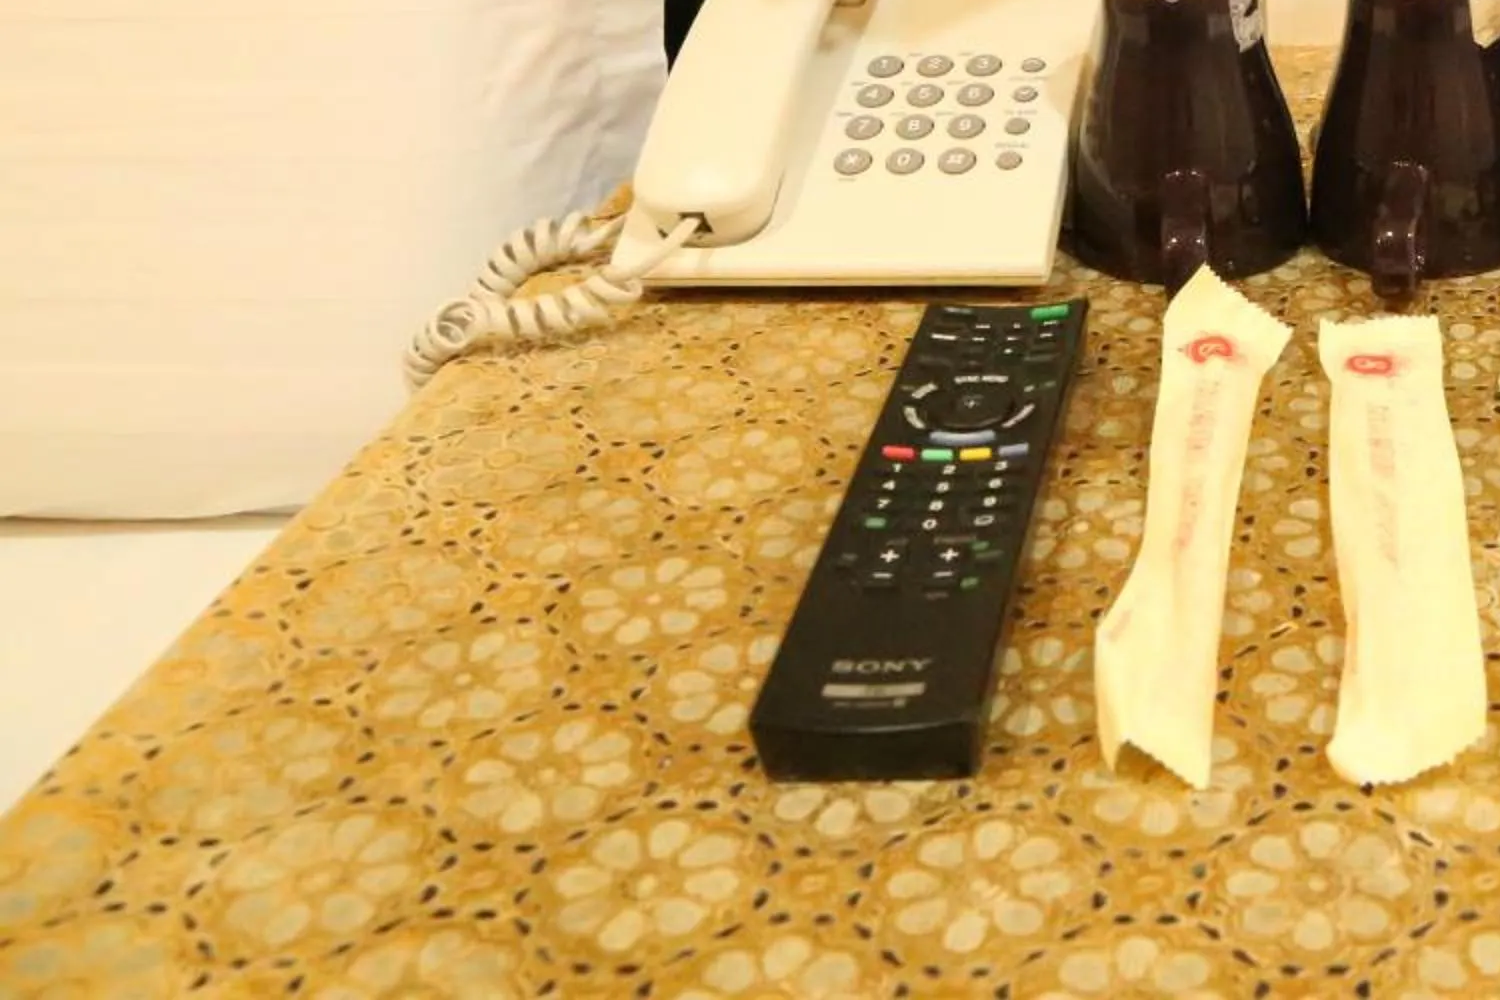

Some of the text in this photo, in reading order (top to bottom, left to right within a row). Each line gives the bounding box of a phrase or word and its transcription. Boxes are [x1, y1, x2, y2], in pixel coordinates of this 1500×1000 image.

[882, 480, 896, 490] 4
[877, 498, 892, 509] 7
[922, 519, 938, 530] 0
[832, 659, 931, 673] SONY
